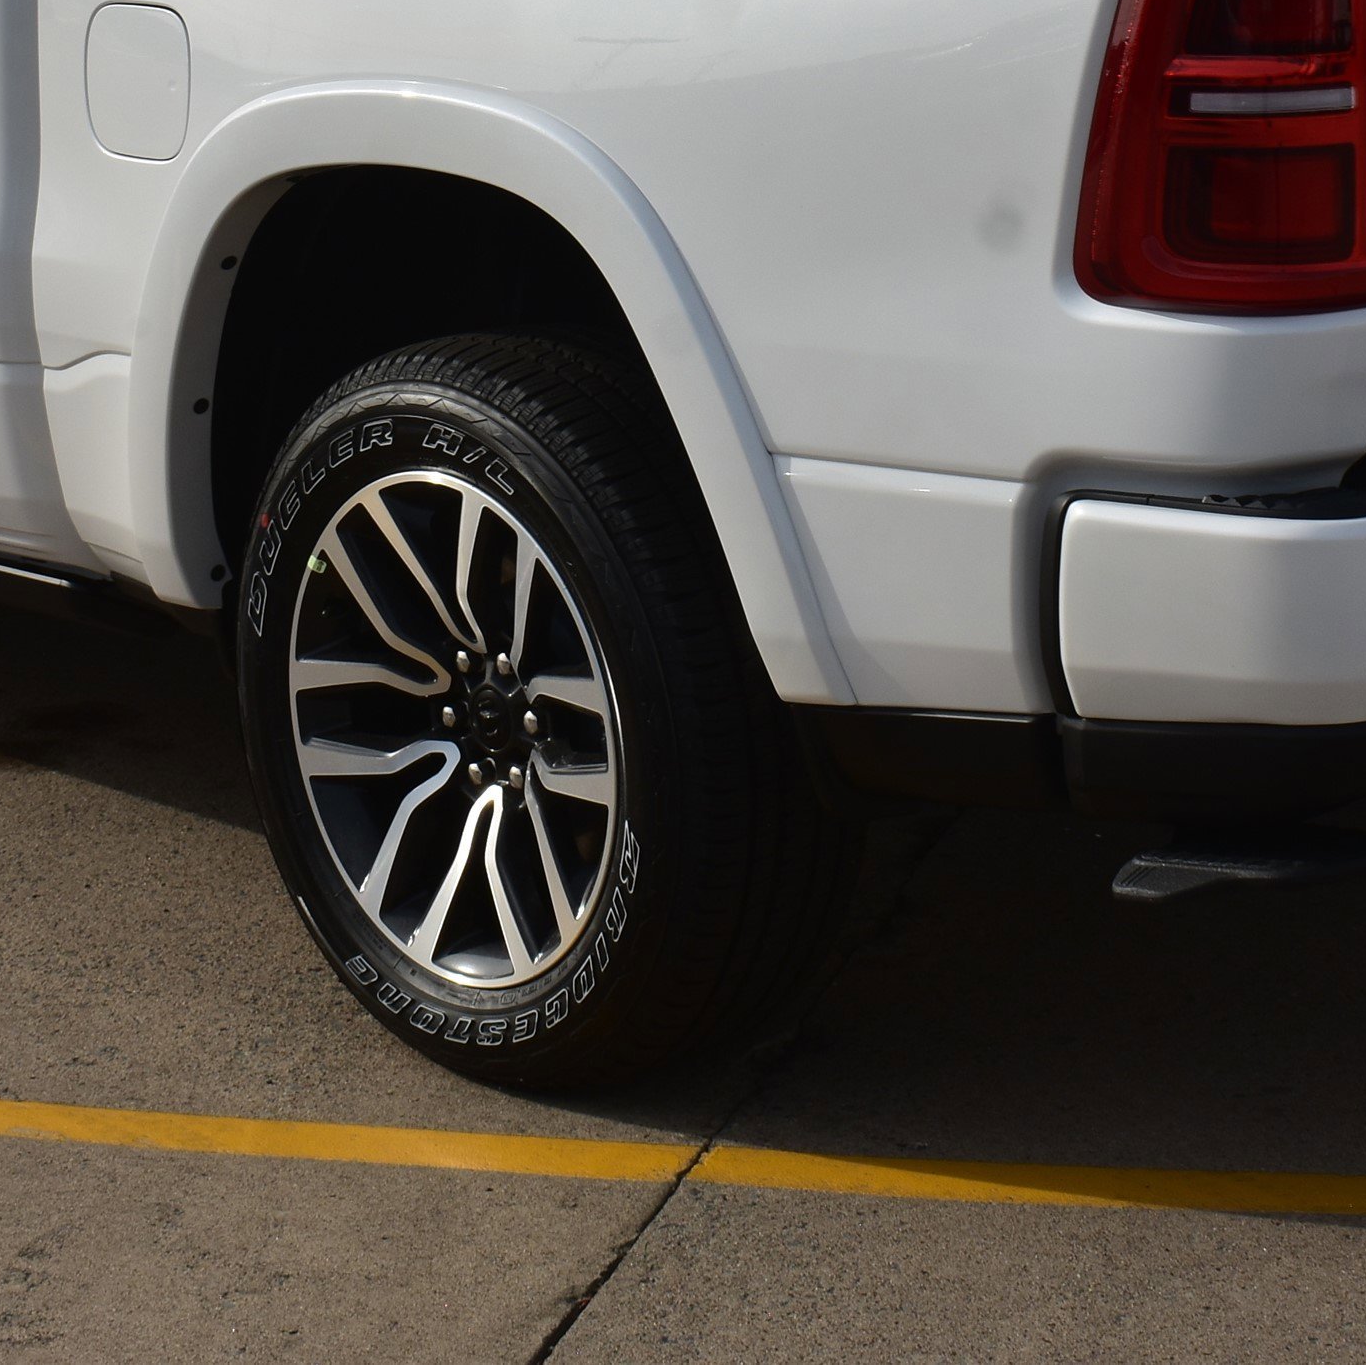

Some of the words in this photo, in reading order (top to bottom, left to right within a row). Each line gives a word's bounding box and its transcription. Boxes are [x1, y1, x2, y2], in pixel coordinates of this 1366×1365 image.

[248, 419, 393, 637] DUELER
[423, 423, 514, 495] H/L
[345, 820, 640, 1046] BRIDGESTONE
